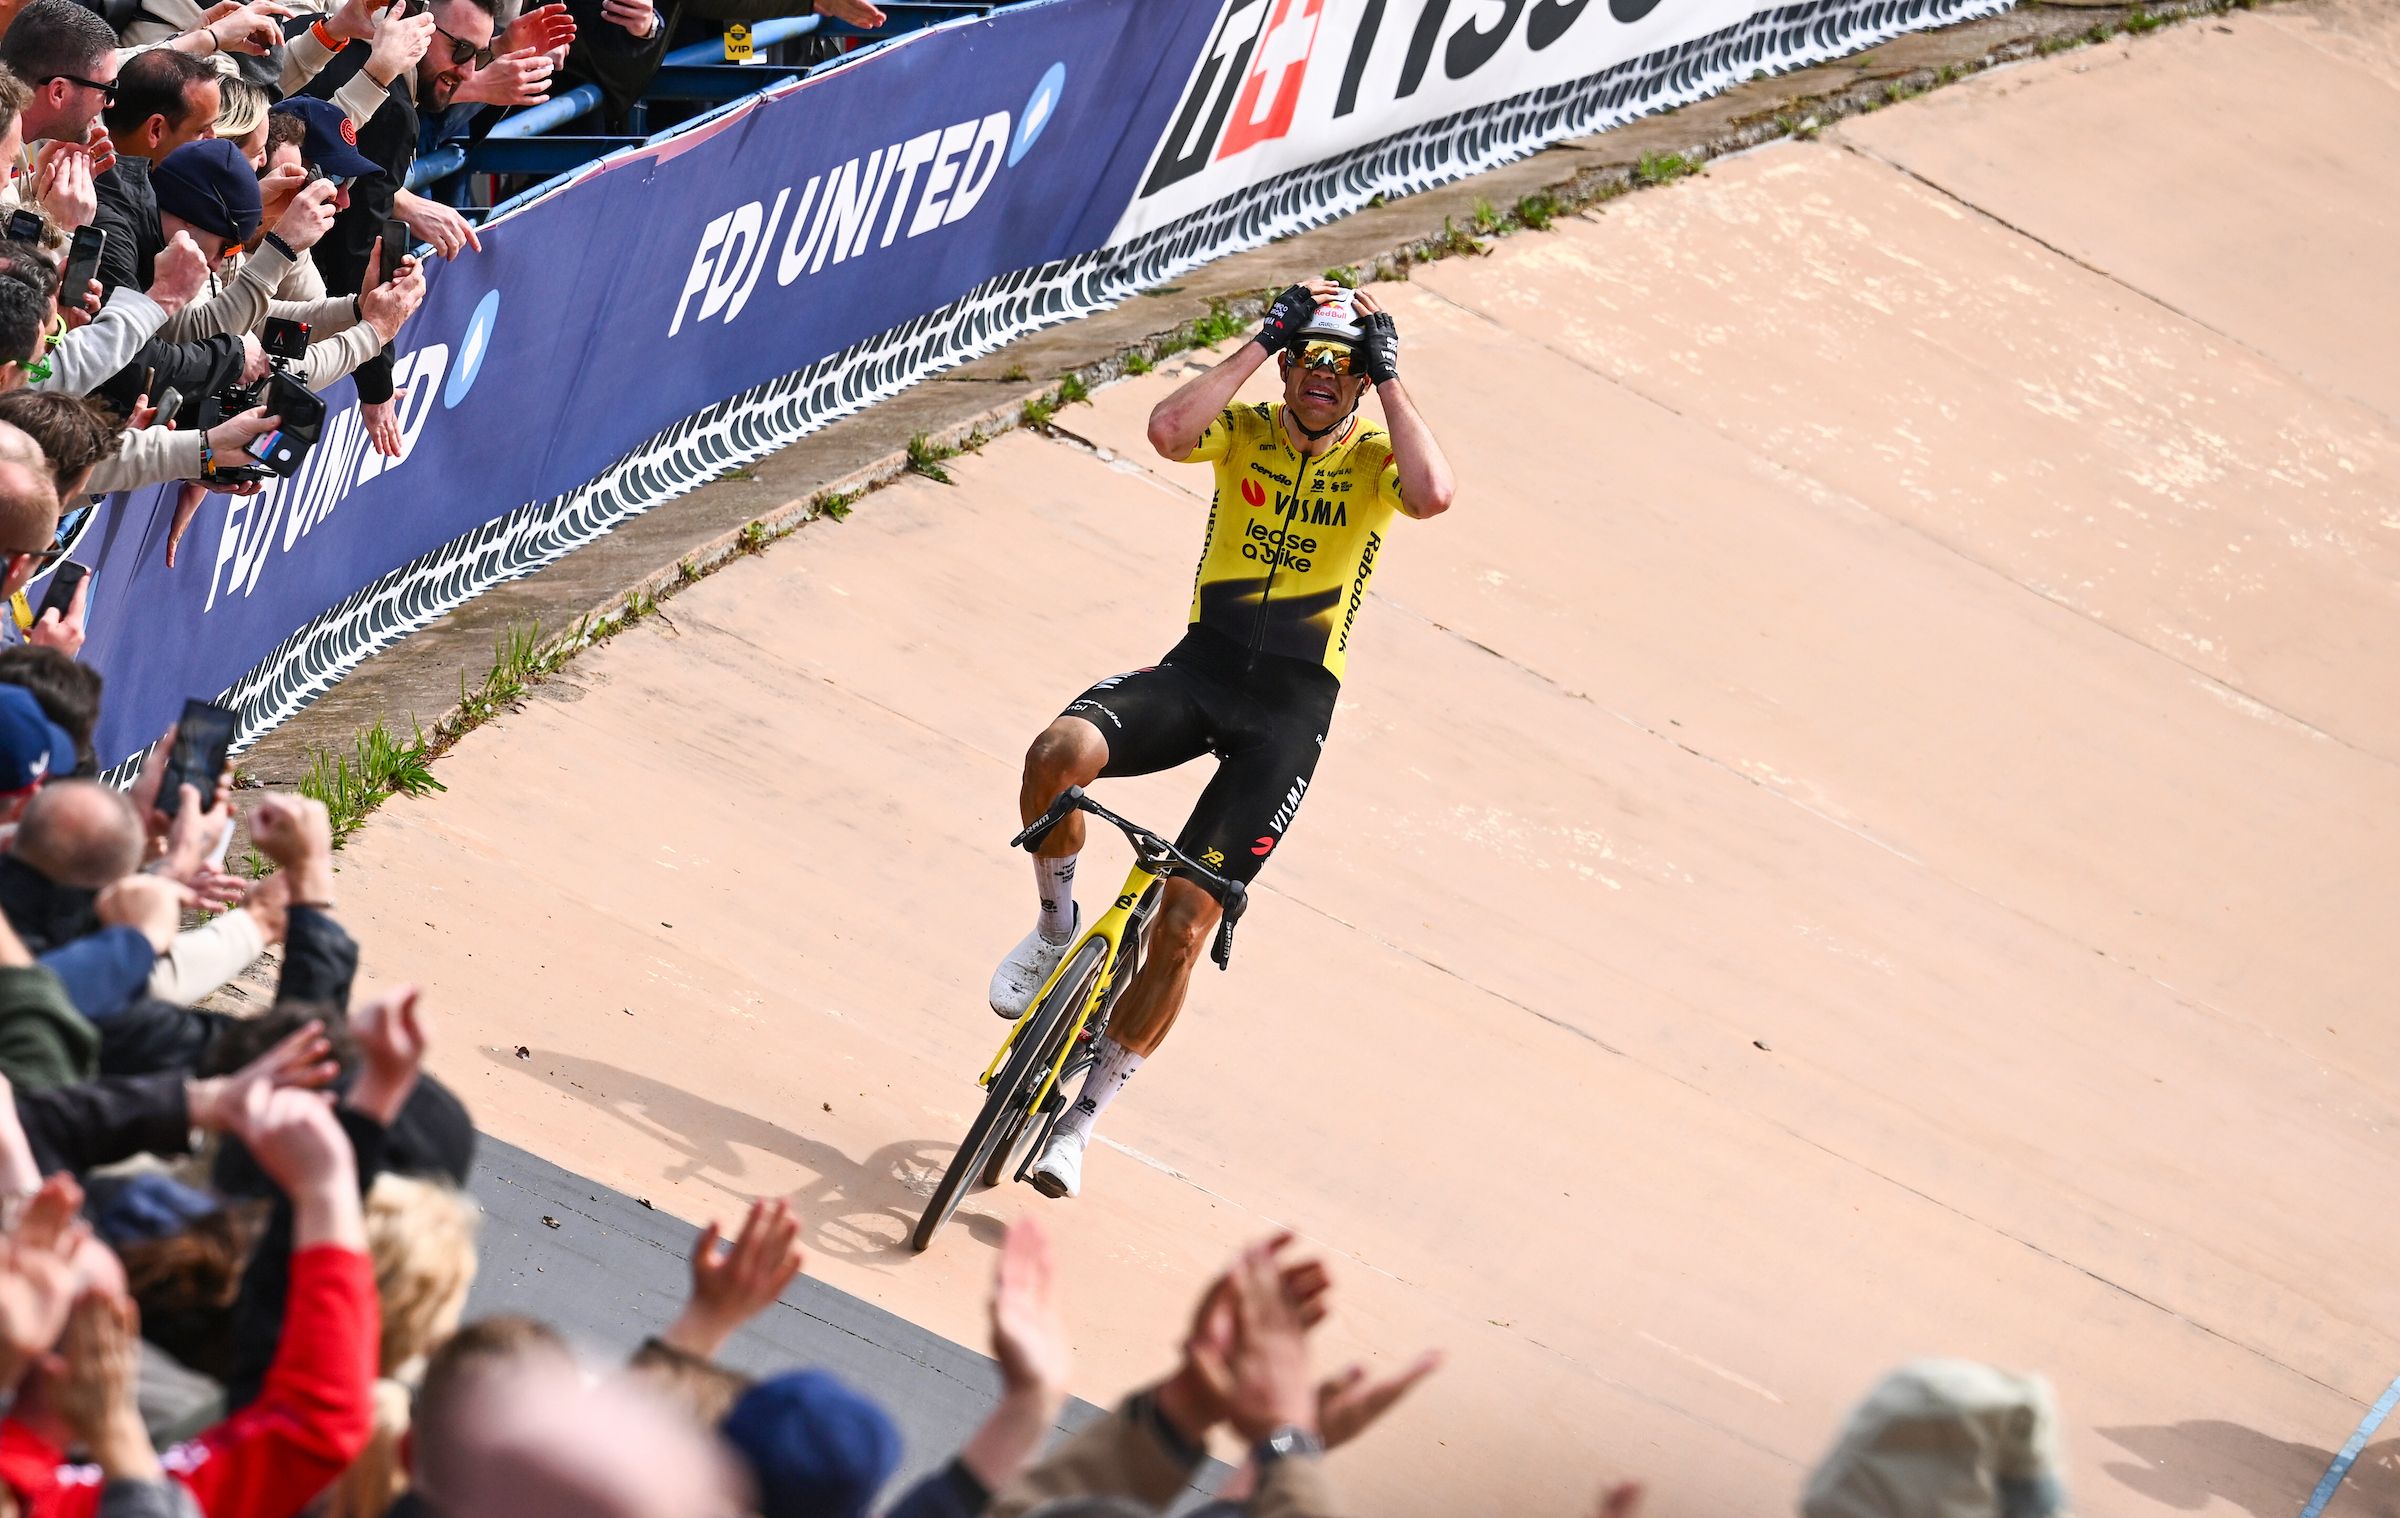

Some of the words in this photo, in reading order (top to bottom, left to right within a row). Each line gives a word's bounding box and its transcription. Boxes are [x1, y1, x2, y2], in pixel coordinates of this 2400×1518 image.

[728, 45, 750, 53] VIP
[667, 186, 792, 338] FDJ
[777, 110, 1011, 288] UNITED
[1331, 311, 1347, 319] Bull
[1250, 462, 1293, 487] cervélo
[1275, 490, 1347, 527] VISMA
[204, 463, 290, 613] FDJ
[1245, 517, 1317, 554] lease
[1338, 530, 1381, 654] Rabobank
[1269, 775, 1308, 834] VISMA
